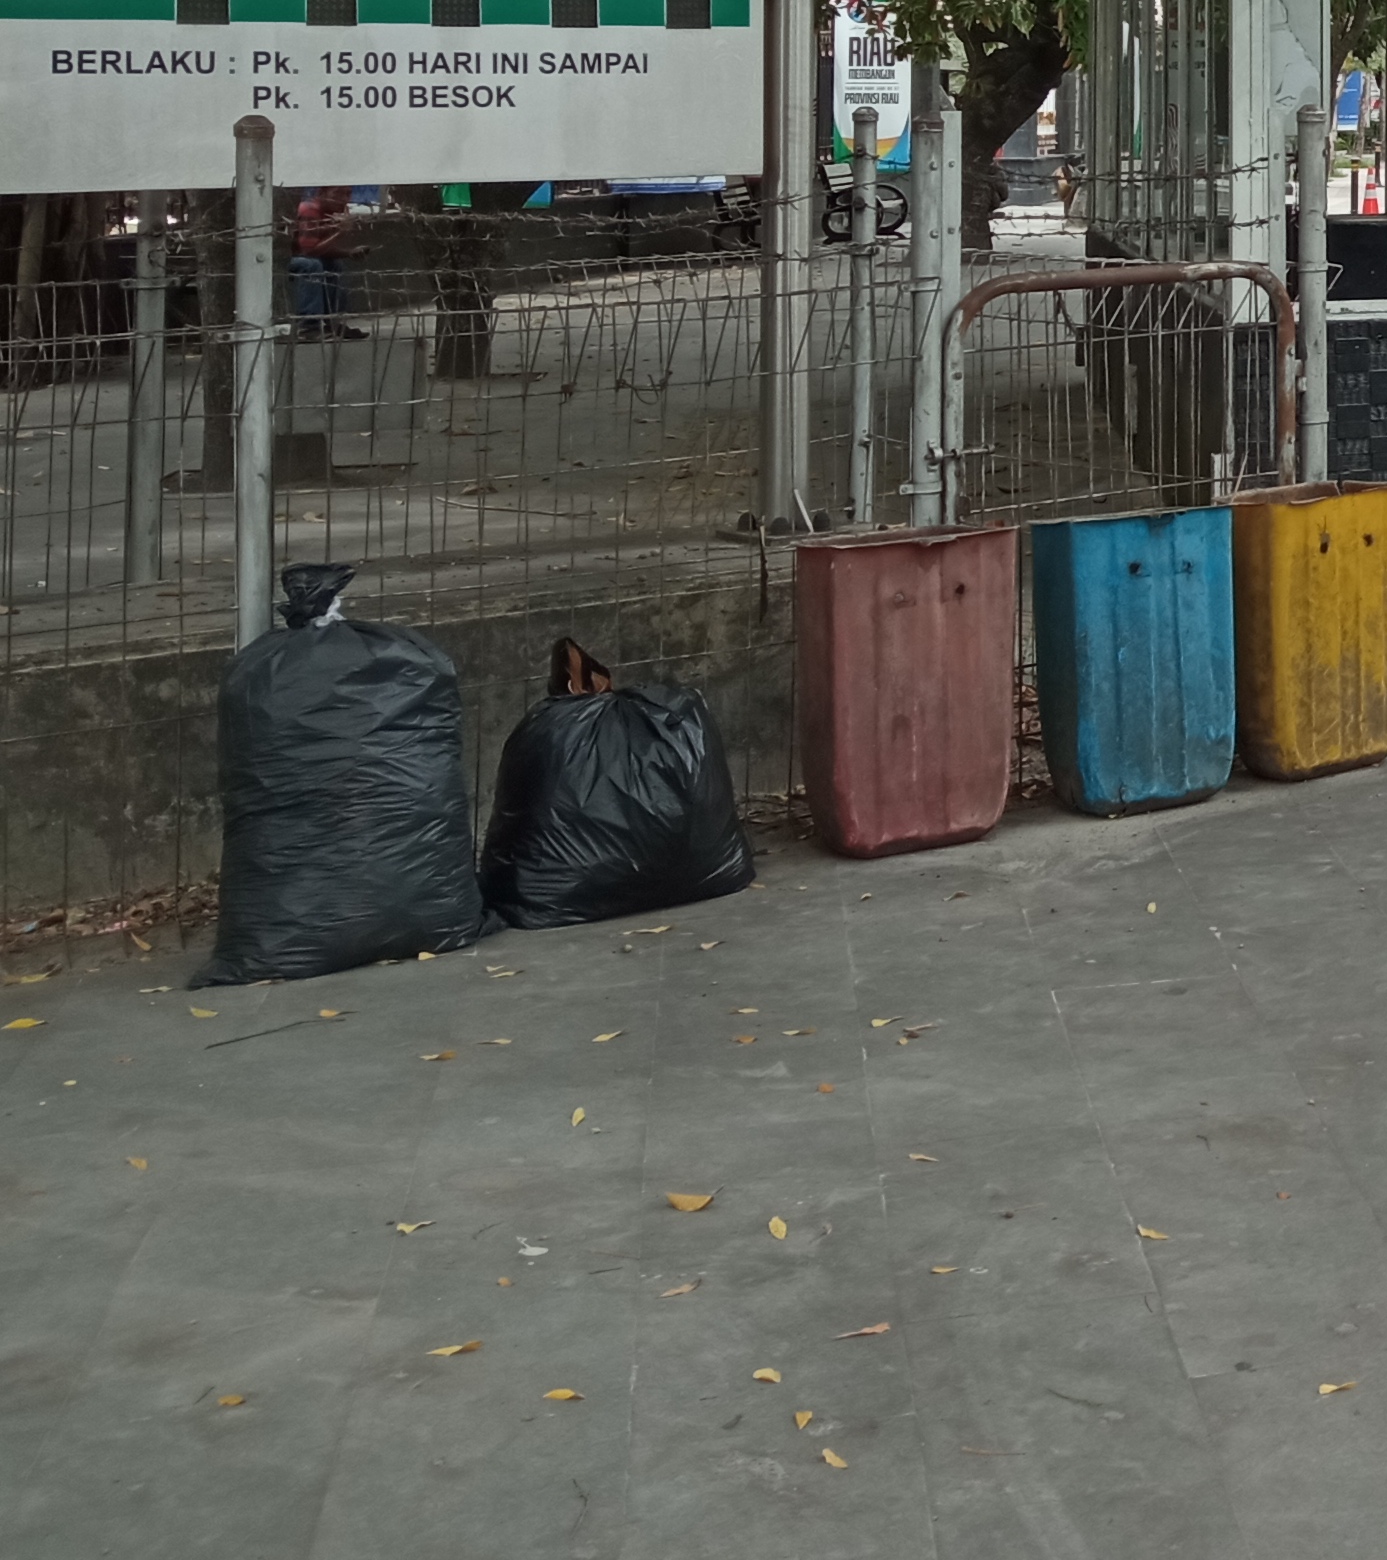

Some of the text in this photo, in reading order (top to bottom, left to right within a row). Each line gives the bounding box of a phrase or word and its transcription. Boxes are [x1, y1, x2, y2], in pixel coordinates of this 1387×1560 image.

[51, 50, 216, 74] BERLAKU
[252, 51, 299, 74] Pk.
[319, 51, 397, 74] 15.00
[408, 51, 481, 74] HARI
[492, 52, 528, 74] INI
[538, 52, 649, 74] SAMPAI
[849, 37, 895, 66] RIAU
[252, 85, 517, 109] Pk. 15.00 BESOK
[845, 93, 899, 104] PROVINSI RIAU
